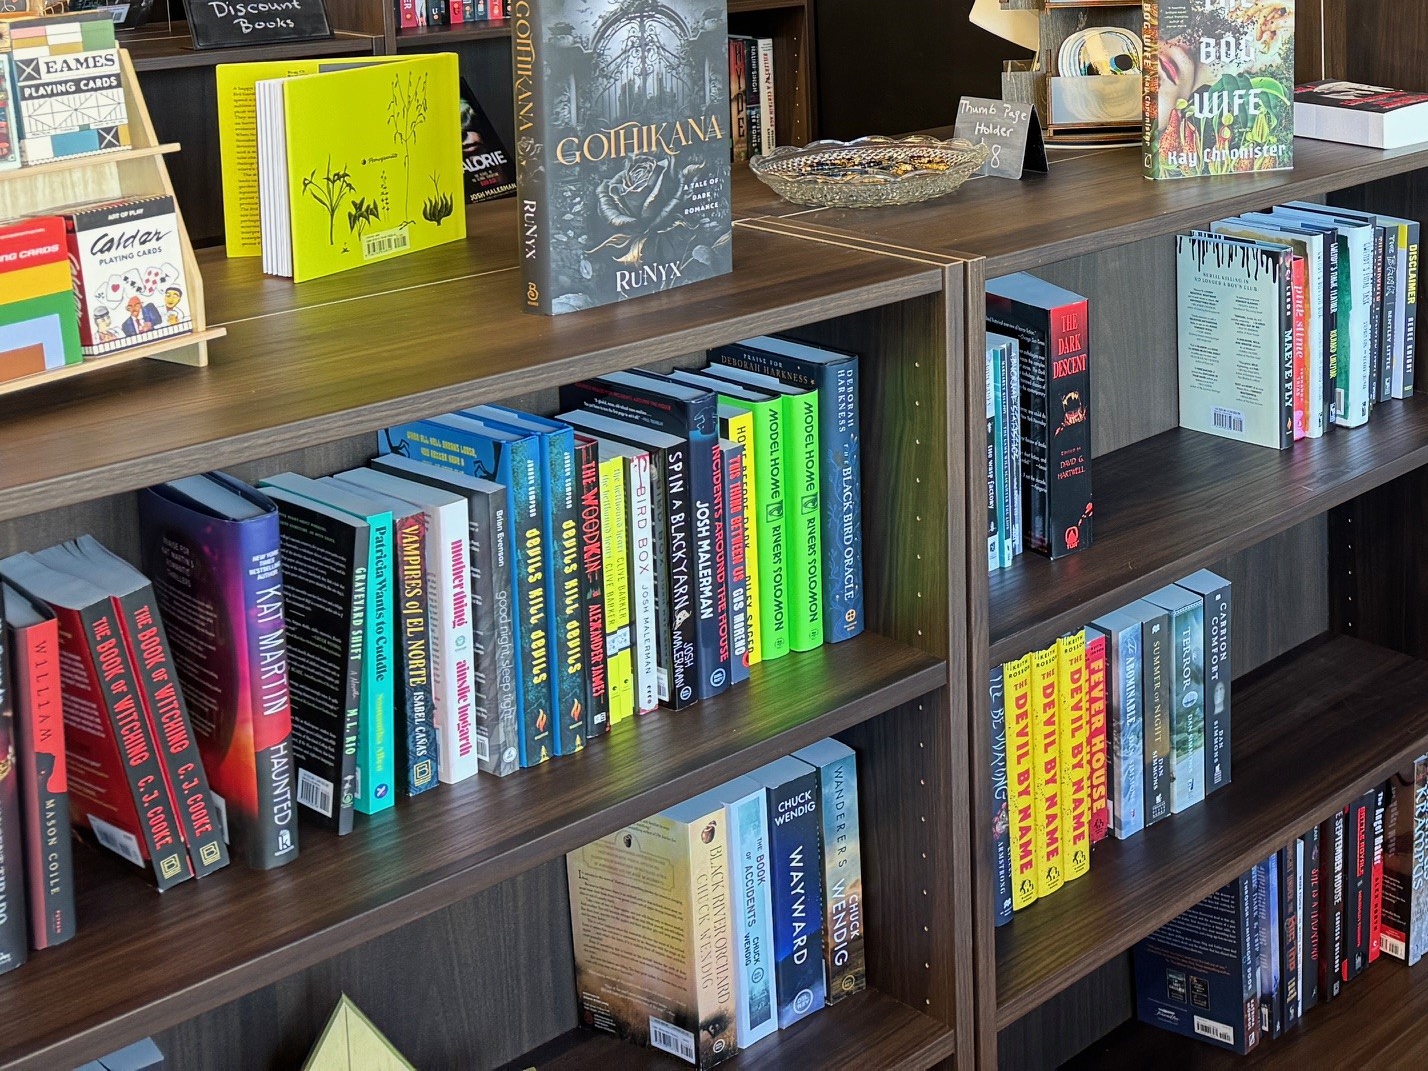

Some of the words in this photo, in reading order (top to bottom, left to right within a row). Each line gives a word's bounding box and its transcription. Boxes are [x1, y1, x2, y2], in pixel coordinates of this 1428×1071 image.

[240, 16, 295, 33] Books
[45, 54, 115, 75] EAMES
[516, 0, 535, 132] GOTHIKANA
[1200, 35, 1255, 64] BOG
[24, 82, 75, 98] PLAYING
[80, 76, 118, 90] CARDS
[1194, 89, 1264, 118] WIFE
[960, 100, 997, 115] Thumb
[1003, 104, 1026, 124] Page
[975, 122, 1013, 137] Holder
[557, 115, 723, 165] GOTHIKANA
[1168, 151, 1197, 167] Kay
[1204, 144, 1286, 163] Chronister
[685, 203, 719, 216] ROMANCE
[90, 228, 172, 256] Calder
[99, 253, 134, 266] PLAYING
[137, 246, 162, 257] CARDS
[1408, 244, 1418, 305] DISCLAIMER
[1061, 313, 1078, 333] THE
[1058, 333, 1082, 356] DARK
[1284, 329, 1292, 375] MAEVE
[1053, 353, 1086, 380] DESCENT
[838, 369, 846, 433] HARKNESS
[769, 409, 779, 457] MODEL
[669, 451, 684, 494] SPIN
[770, 459, 780, 499] HOME
[636, 485, 647, 530] BIRD
[672, 500, 683, 510] A
[671, 514, 687, 557] BLACK
[774, 524, 782, 562] RIVERS
[401, 524, 422, 600] VAMPIRES
[638, 539, 650, 575] BOX
[255, 584, 283, 624] KAT
[672, 560, 689, 610] YARN
[775, 565, 785, 632] SOLOMON
[407, 616, 424, 636] EL
[408, 600, 422, 614] of
[408, 637, 427, 687] NORTE
[672, 630, 685, 688] MALERMAN
[683, 642, 694, 667] JOSH
[1182, 626, 1191, 691] TERROR
[1211, 616, 1219, 681] COMFORT
[259, 631, 290, 717] MARTIN
[1014, 678, 1028, 692] THE
[1089, 660, 1105, 728] FEVER
[413, 690, 425, 727] ISABEL
[1014, 691, 1030, 765] DEVIL
[415, 729, 428, 757] CAÑAS
[270, 742, 290, 826] HAUNTED
[1017, 772, 1031, 799] BY
[1089, 731, 1106, 812] HOUSE
[775, 802, 816, 826] WENDIG
[778, 790, 812, 813] CHUCK
[834, 765, 847, 869] WANDERERS
[1017, 809, 1034, 875] NAME
[1334, 824, 1344, 880] SEPTEMBER
[1412, 784, 1428, 891] KRAMPUS
[755, 853, 767, 885] BOOK
[696, 872, 711, 923] CHUCK
[745, 864, 758, 927] ACCIDENTS
[788, 845, 808, 966] WAYWARD
[1333, 880, 1342, 905] HOUSE
[699, 922, 714, 990] WENDIG
